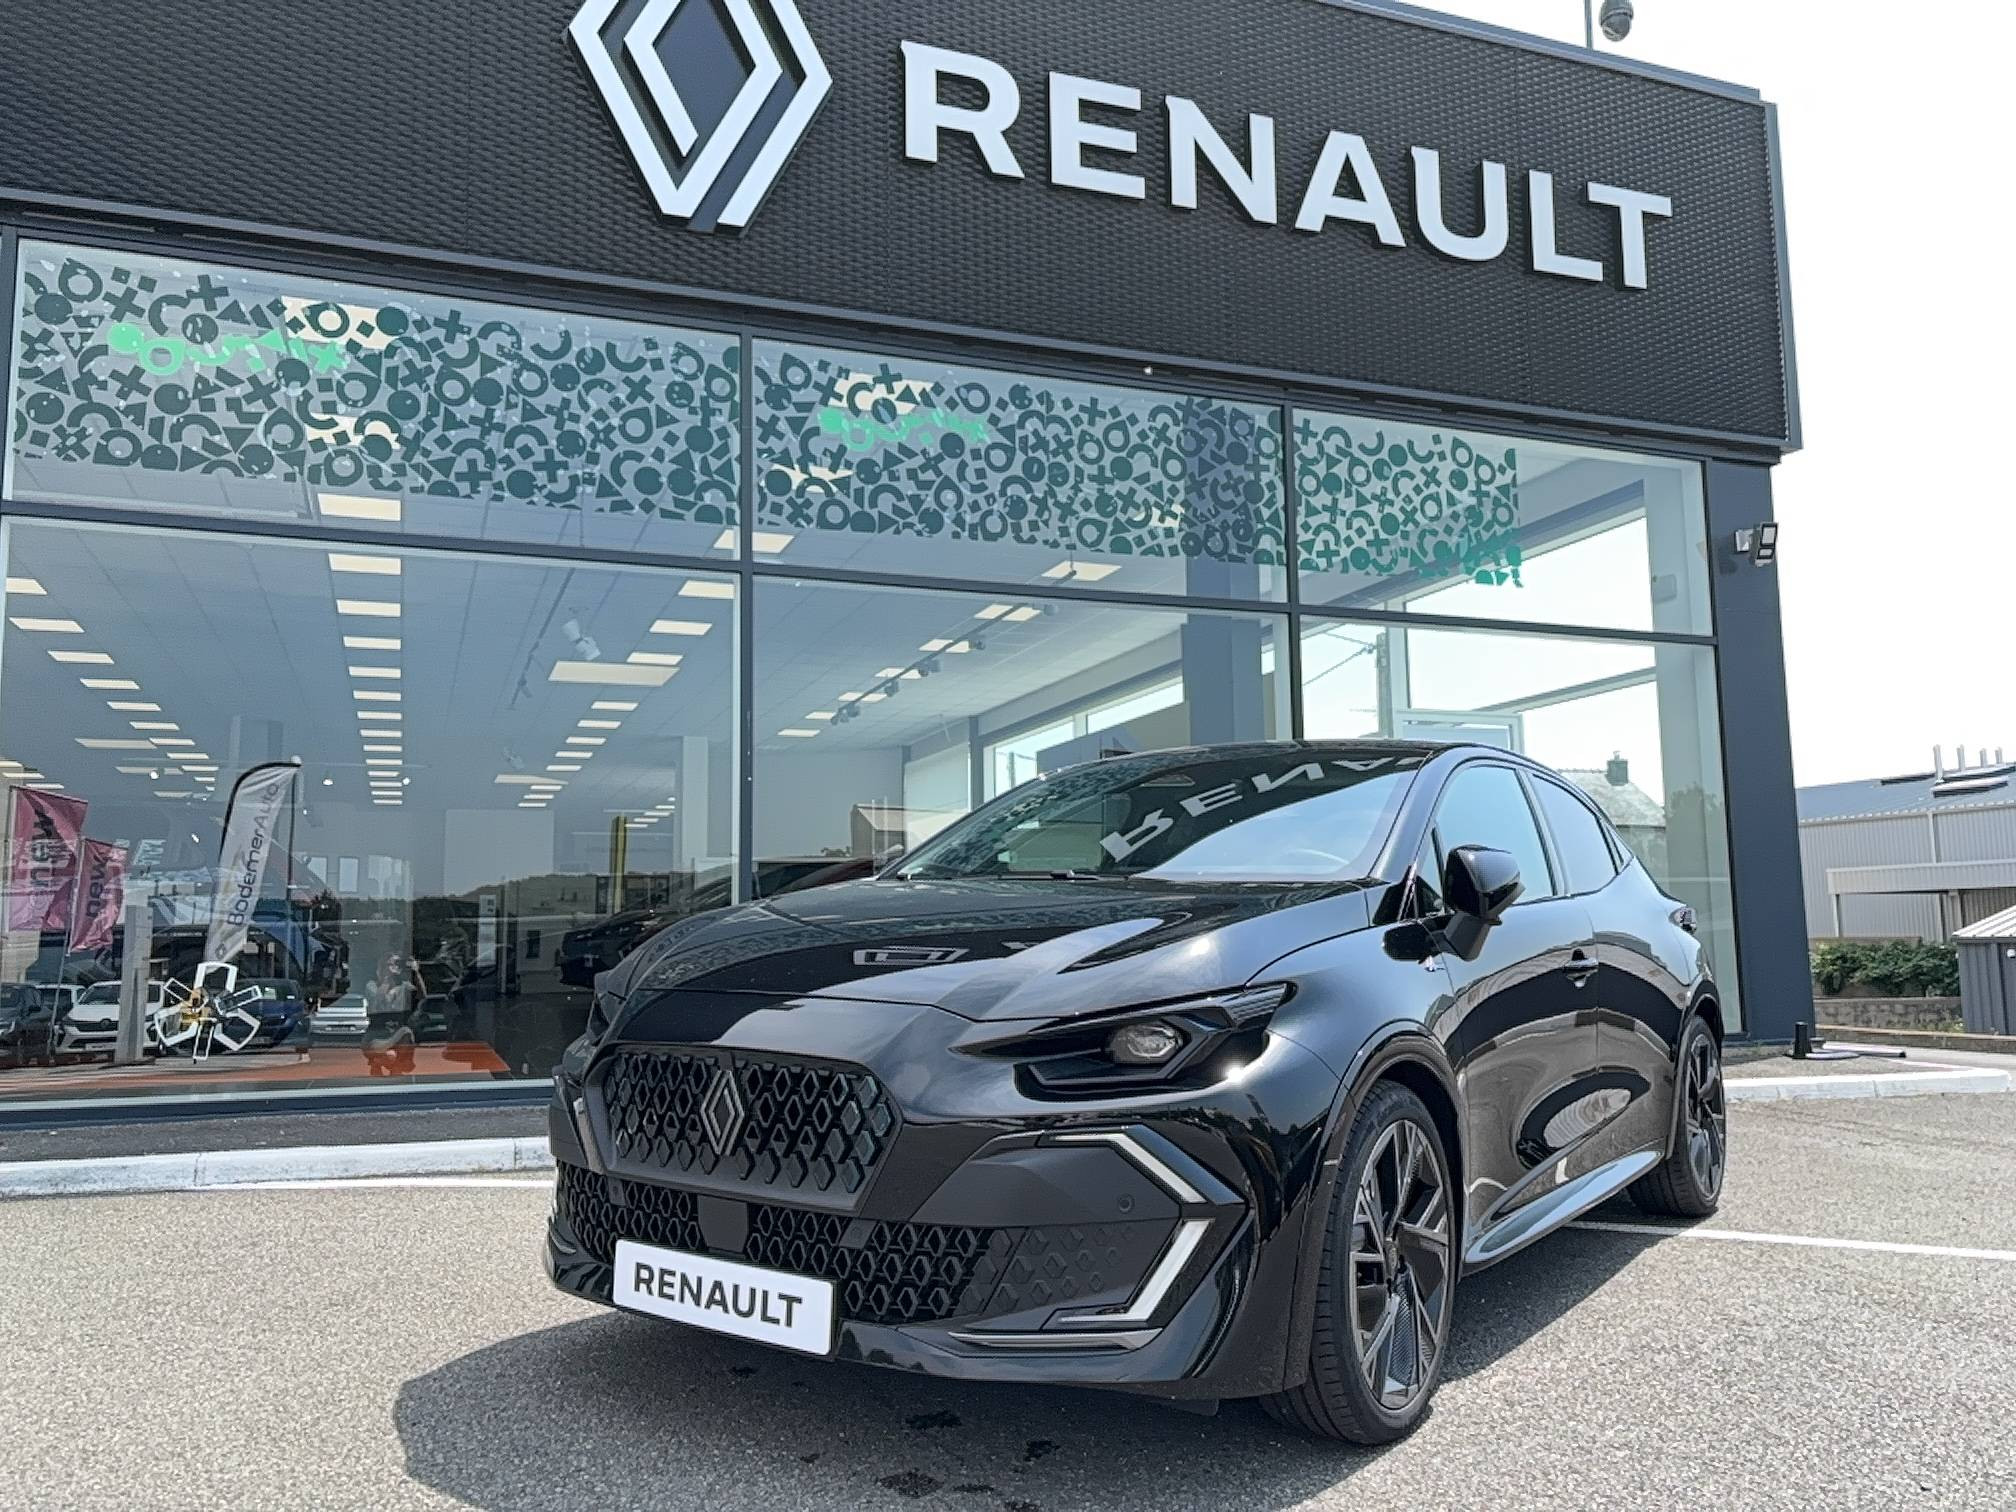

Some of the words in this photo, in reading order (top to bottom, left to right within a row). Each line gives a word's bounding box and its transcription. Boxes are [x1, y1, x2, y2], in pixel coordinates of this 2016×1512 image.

[901, 41, 1671, 288] RENAULT
[86, 855, 109, 918] new
[633, 1261, 803, 1328] RENAULT
